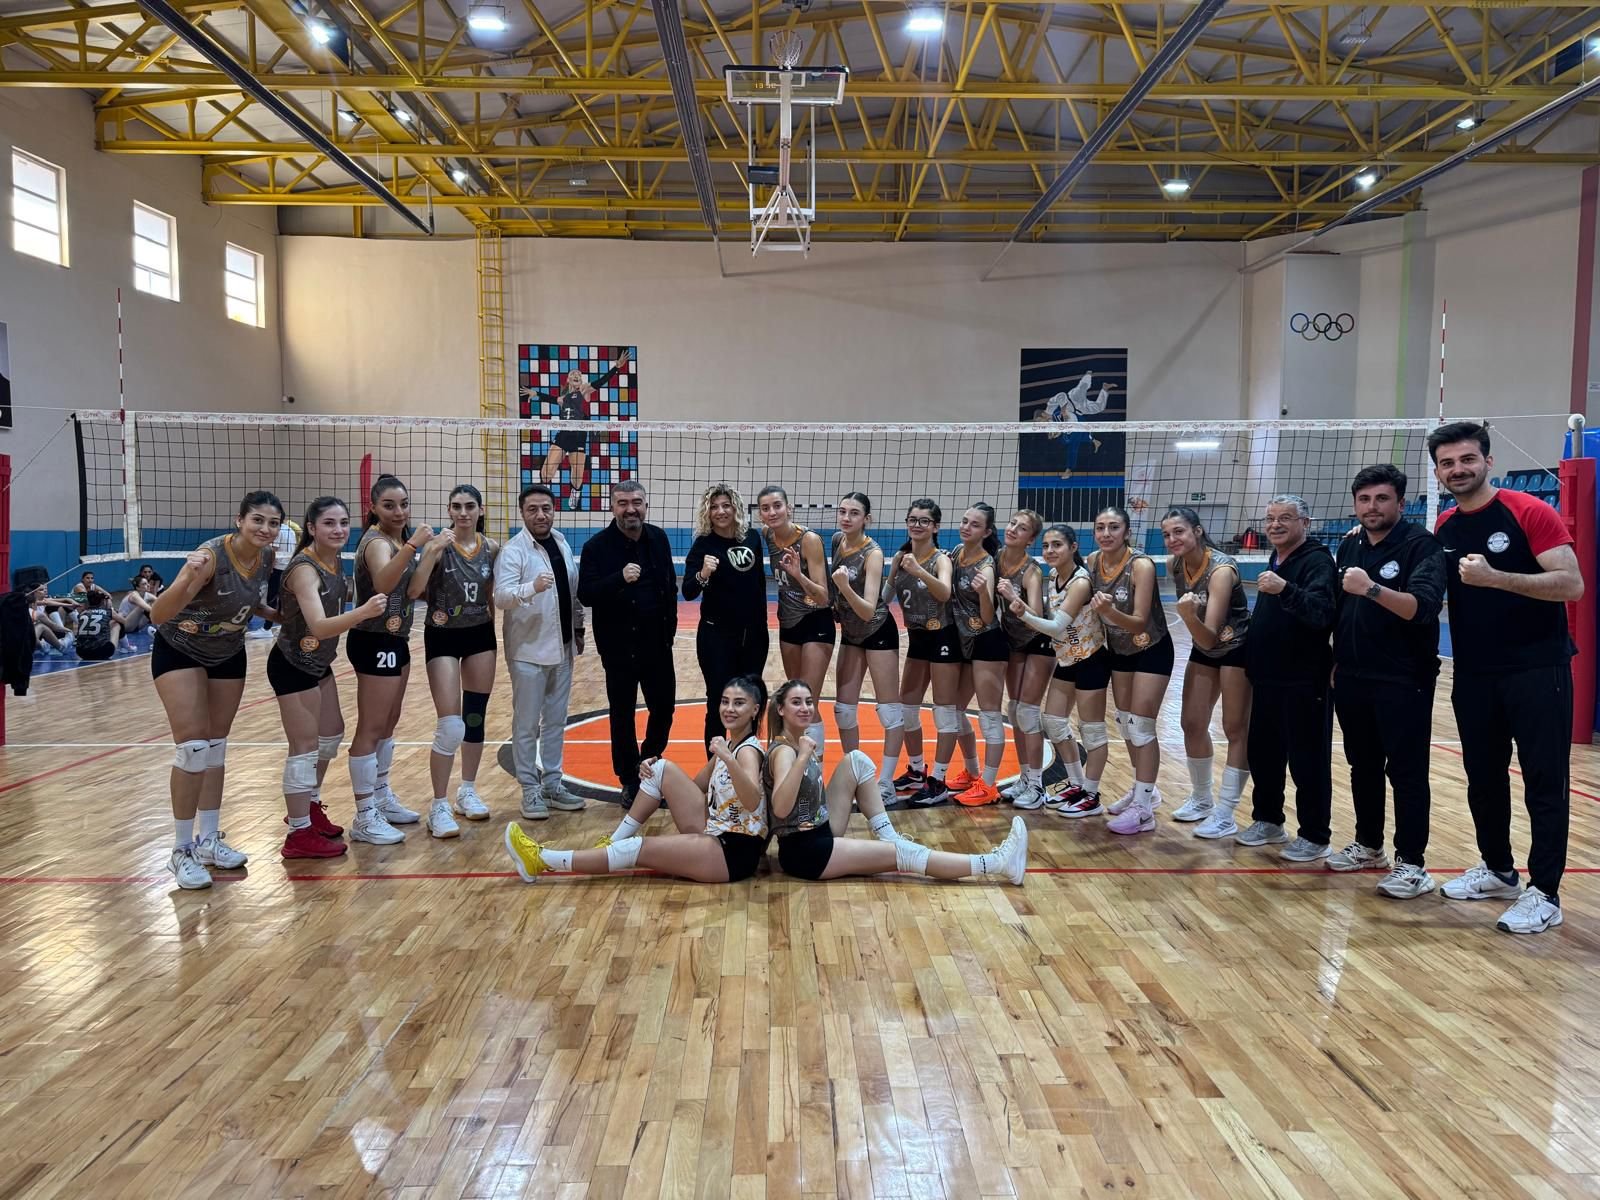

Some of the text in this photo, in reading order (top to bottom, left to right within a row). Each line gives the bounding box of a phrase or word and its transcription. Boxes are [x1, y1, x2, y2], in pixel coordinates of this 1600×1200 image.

[463, 582, 479, 603] 13
[902, 589, 912, 609] 2
[231, 604, 251, 624] 8
[78, 615, 103, 636] 23
[376, 651, 397, 669] 20
